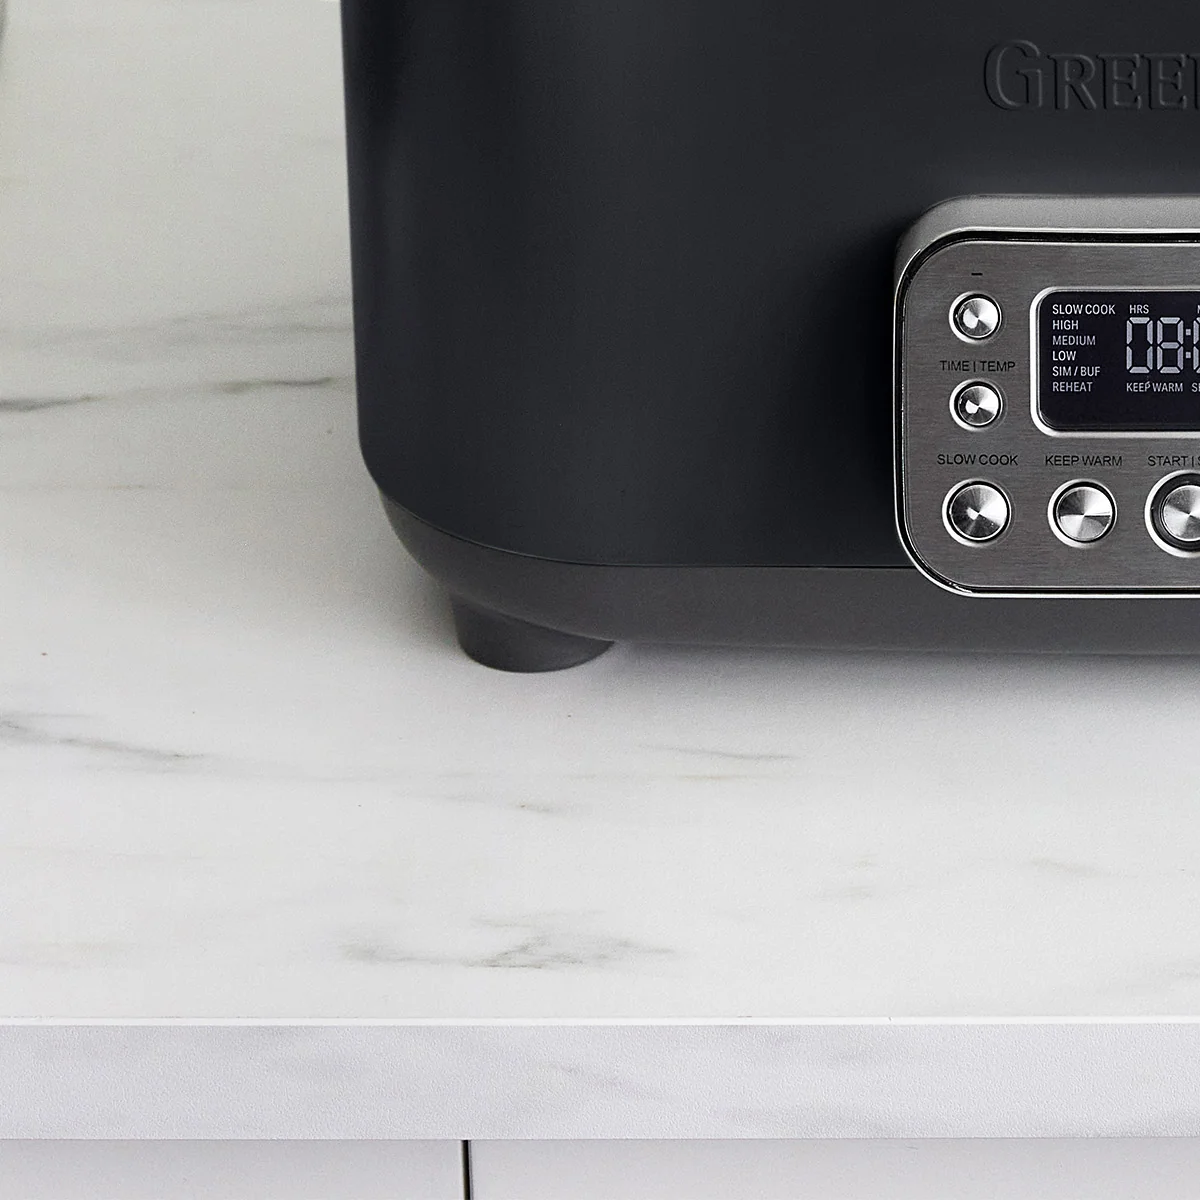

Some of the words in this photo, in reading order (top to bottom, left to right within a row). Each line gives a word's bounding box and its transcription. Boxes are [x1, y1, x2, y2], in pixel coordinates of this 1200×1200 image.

[1052, 304, 1083, 315] SLOW
[1085, 304, 1116, 315] COOK
[1129, 304, 1149, 315] HRS
[1052, 320, 1079, 331] HIGH
[1052, 335, 1096, 346] MEDIUM
[1052, 350, 1077, 362] LOW
[940, 360, 970, 372] TIME
[979, 360, 1016, 372] TEMP
[1052, 366, 1071, 377] SIM
[1081, 366, 1101, 377] BUF
[1052, 381, 1093, 392] REHEAT
[1126, 382, 1150, 393] KEEP
[1152, 382, 1184, 393] WARM
[937, 454, 975, 466] SLOW
[978, 454, 1018, 466] COOK
[1045, 455, 1078, 467] KEEP
[1081, 455, 1123, 467] WARM
[1147, 455, 1189, 467] START
